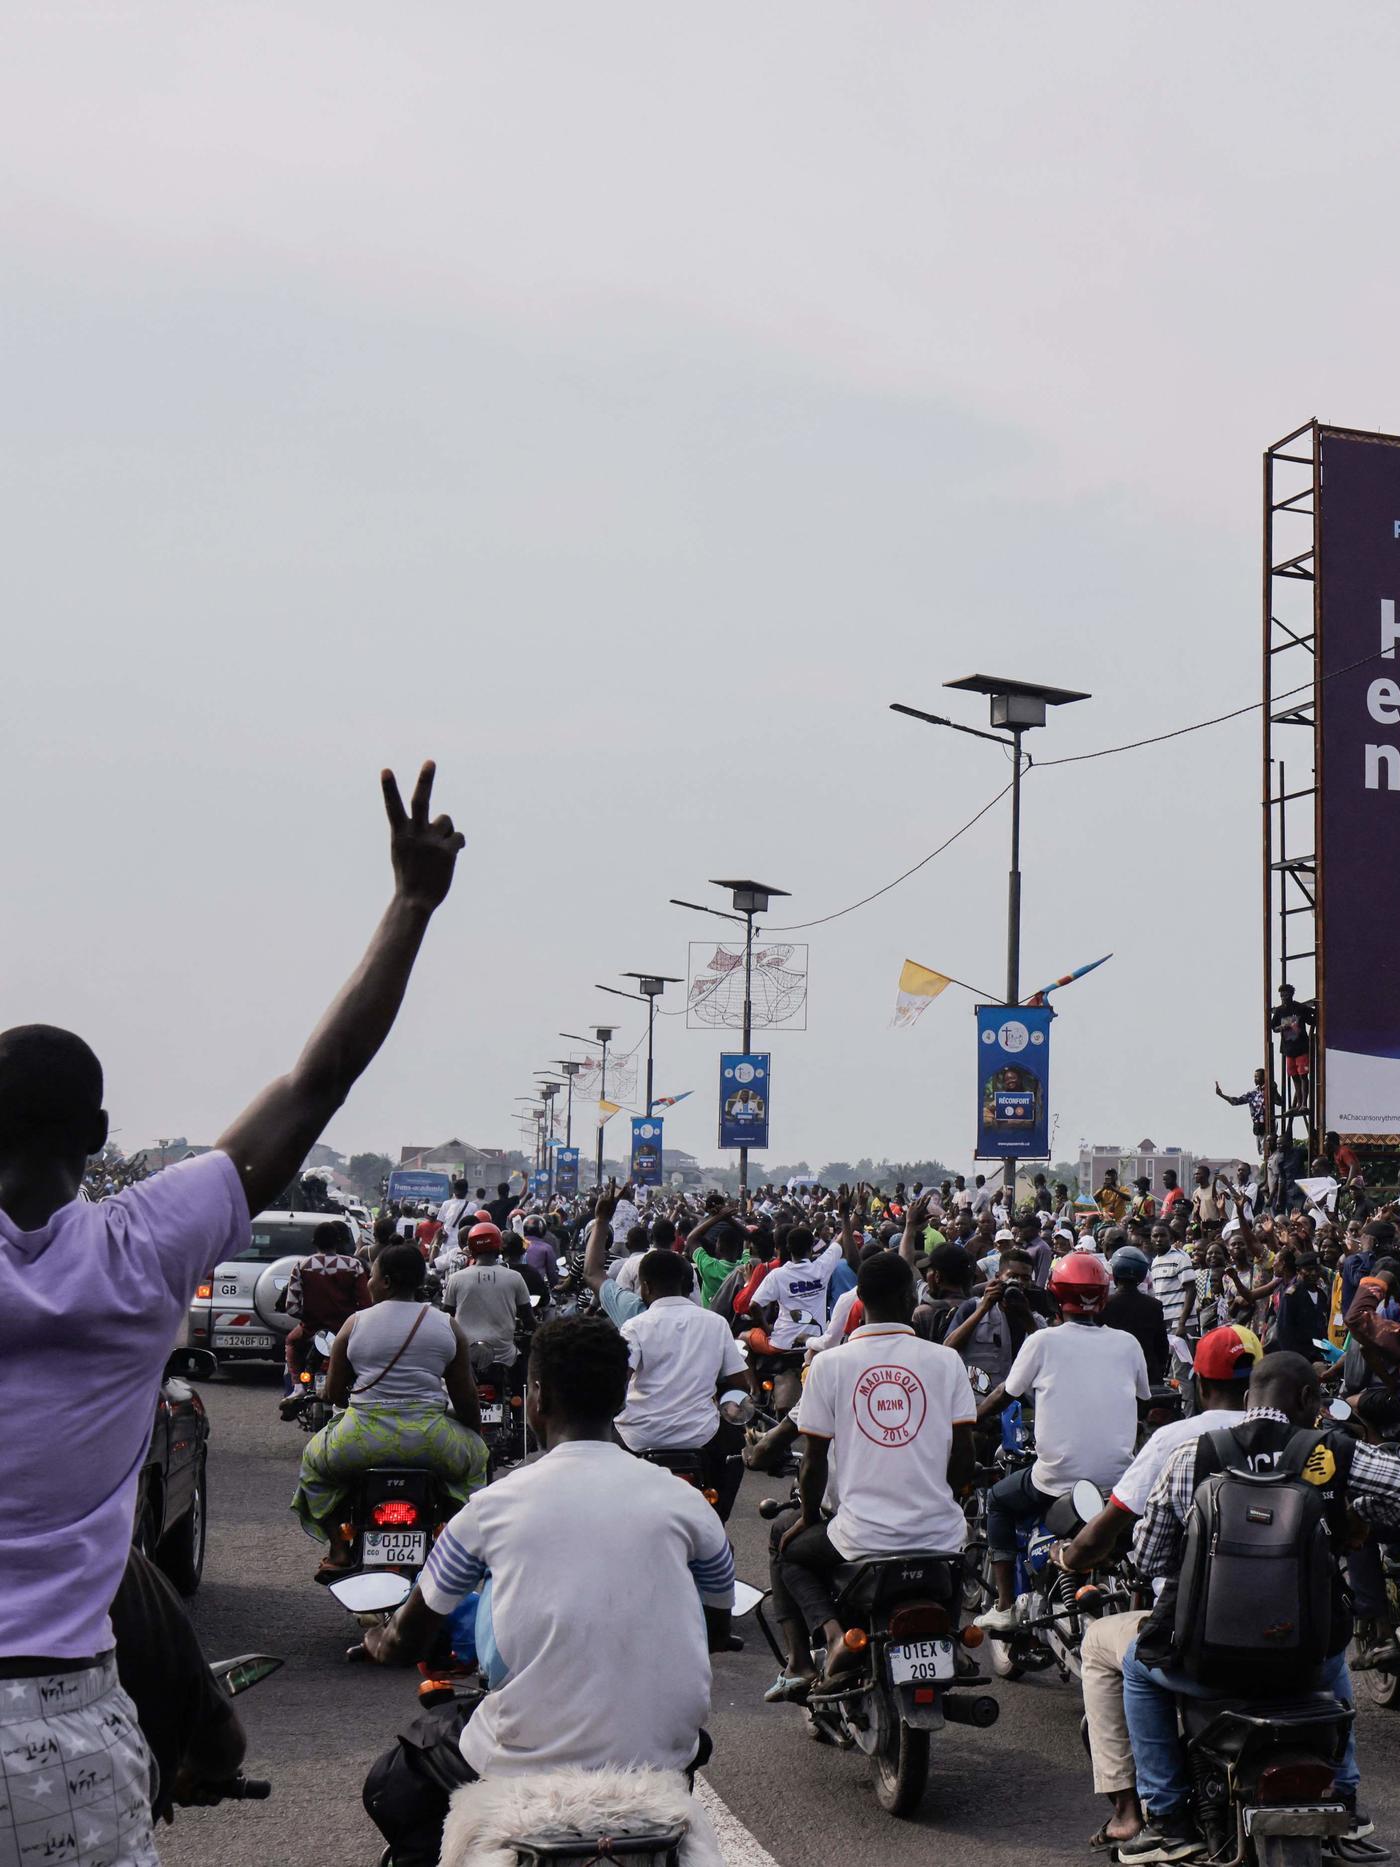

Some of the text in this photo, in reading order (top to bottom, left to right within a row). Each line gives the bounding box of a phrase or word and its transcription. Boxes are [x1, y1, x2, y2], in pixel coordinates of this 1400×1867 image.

[998, 1096, 1031, 1105] RÉCONFORT
[221, 1285, 237, 1295] GB
[859, 1370, 918, 1397] MADINGOU
[877, 1399, 904, 1412] M2NR
[883, 1427, 909, 1441] 2016
[387, 1479, 405, 1487] TVS
[382, 1534, 422, 1548] 01DH
[386, 1548, 415, 1562] 064
[902, 1570, 924, 1580] TVS
[903, 1642, 938, 1660] 01EX
[910, 1662, 937, 1679] 209
